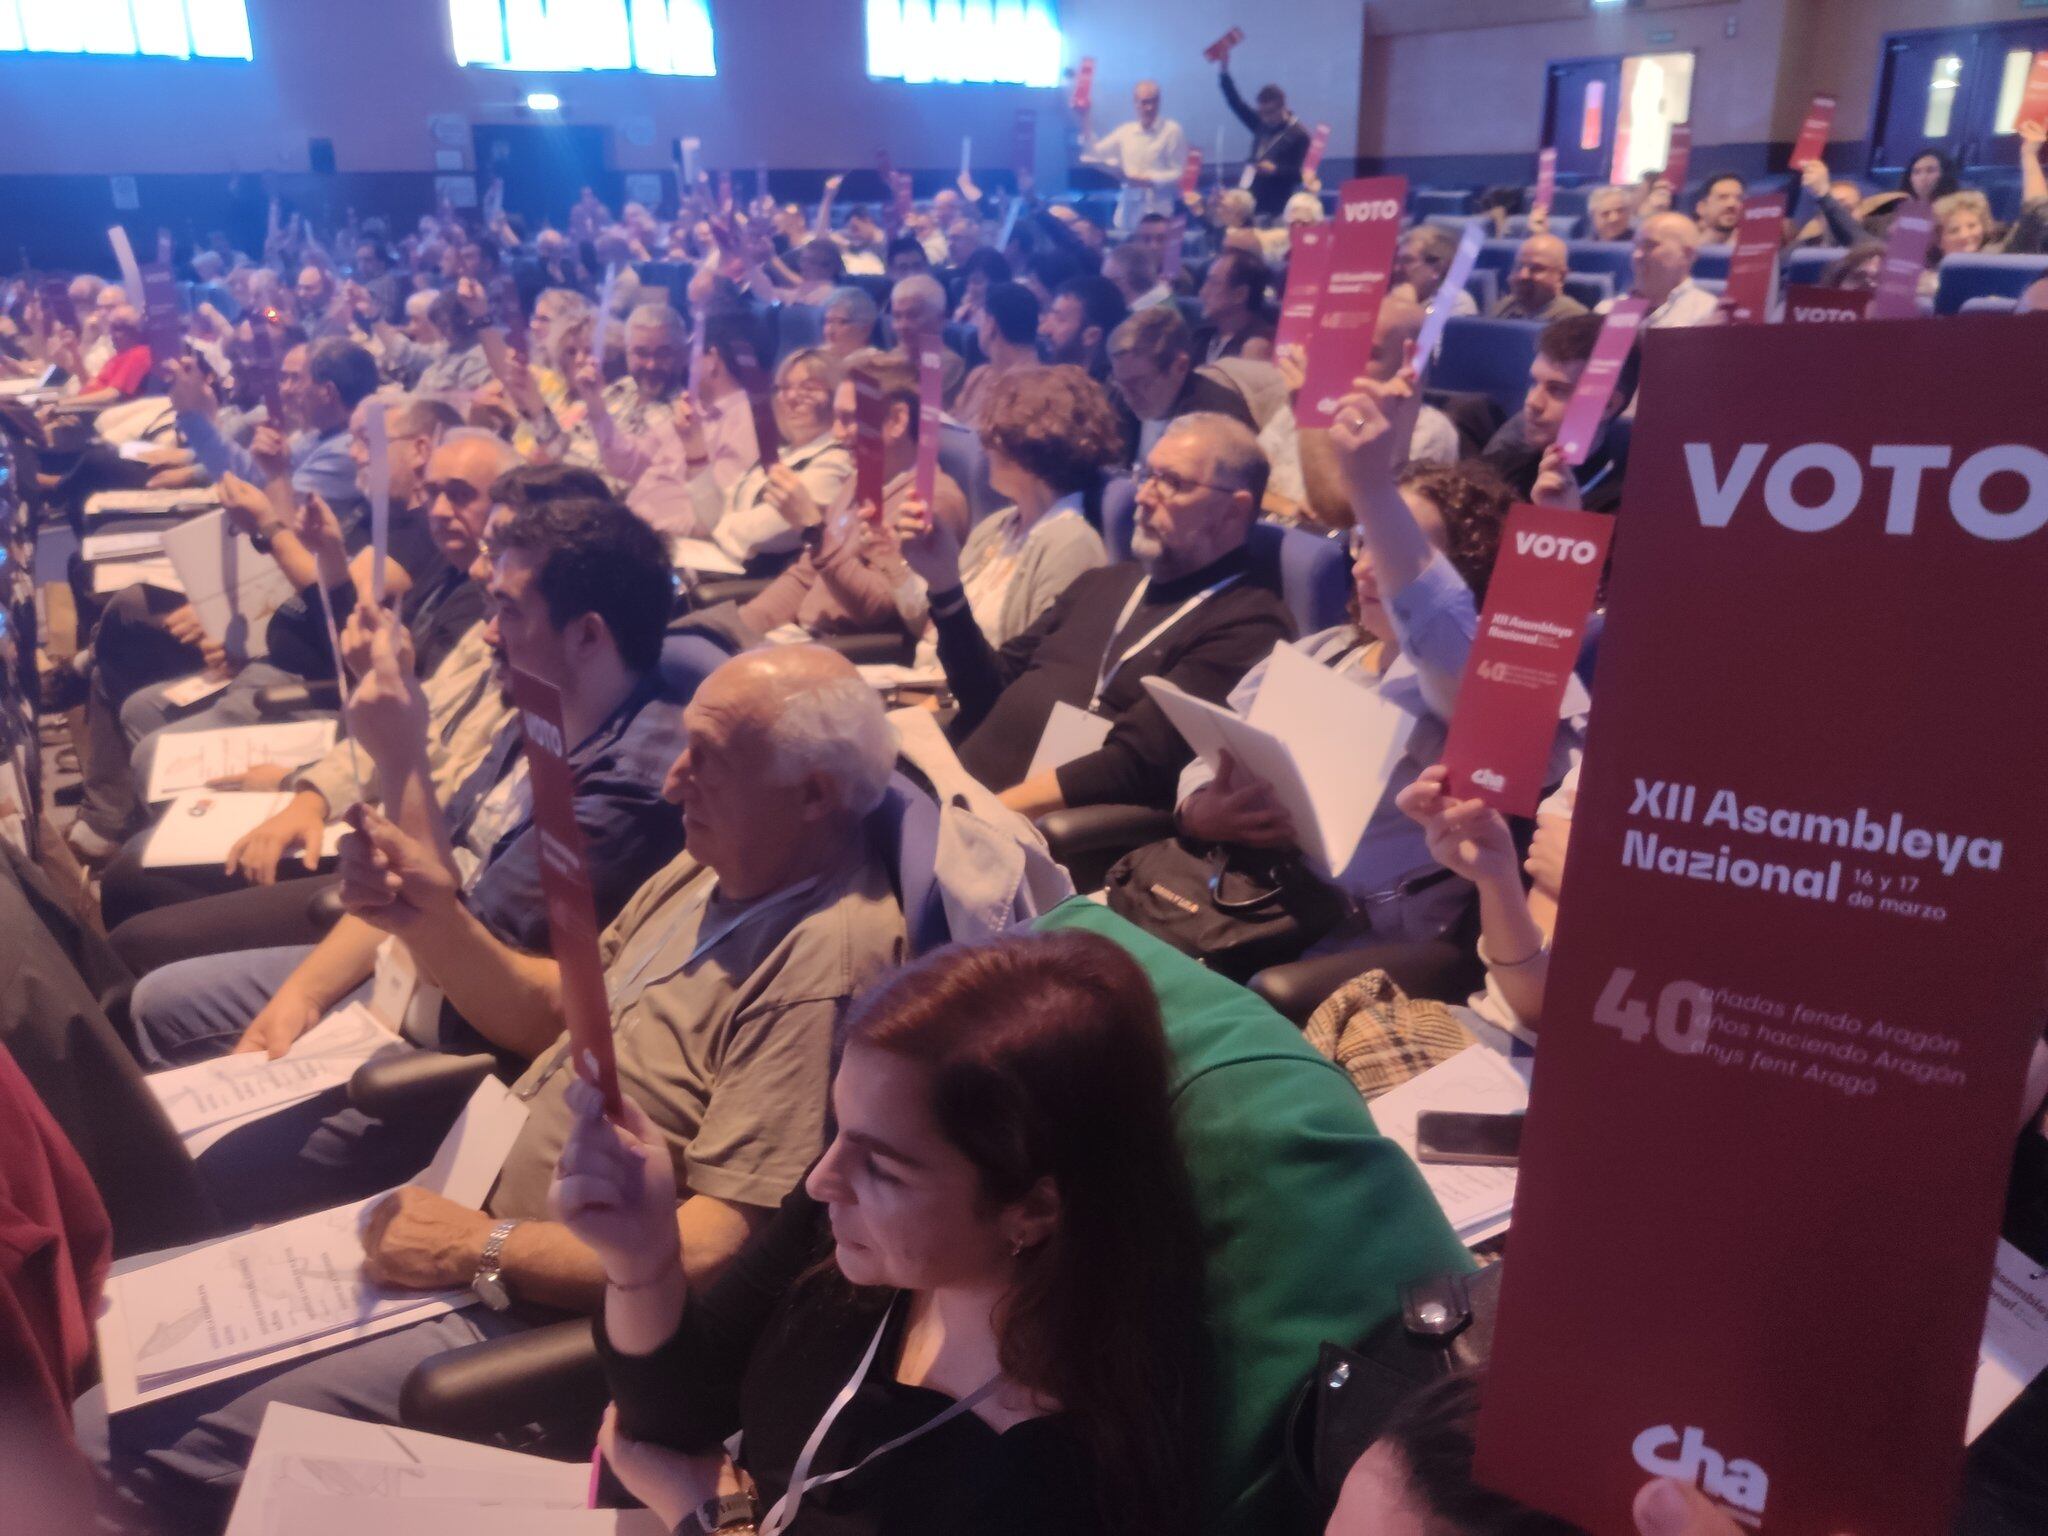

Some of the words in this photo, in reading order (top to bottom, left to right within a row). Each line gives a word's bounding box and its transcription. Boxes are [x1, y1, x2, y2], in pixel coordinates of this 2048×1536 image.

[1344, 199, 1398, 222] VOTO
[1684, 441, 2048, 541] VOTO
[1516, 531, 1597, 565] VOTO
[1628, 778, 1696, 823] XII
[1703, 789, 2003, 876] Asambleya
[1621, 829, 1842, 902] Nazional
[1853, 868, 1874, 886] 16
[1879, 874, 1892, 892] y
[1900, 874, 1921, 893] 17
[1847, 890, 1875, 908] de
[1879, 899, 1946, 922] marzo
[1592, 966, 1713, 1055] 40
[1792, 1003, 1862, 1035] fendo
[1866, 1018, 1962, 1057] Aragón
[1749, 1050, 1800, 1077] fent
[1802, 1063, 1879, 1097] Aragó
[1756, 1023, 1869, 1065] haciendo
[1873, 1049, 1967, 1087] Aragón
[1631, 1423, 1770, 1514] cha
